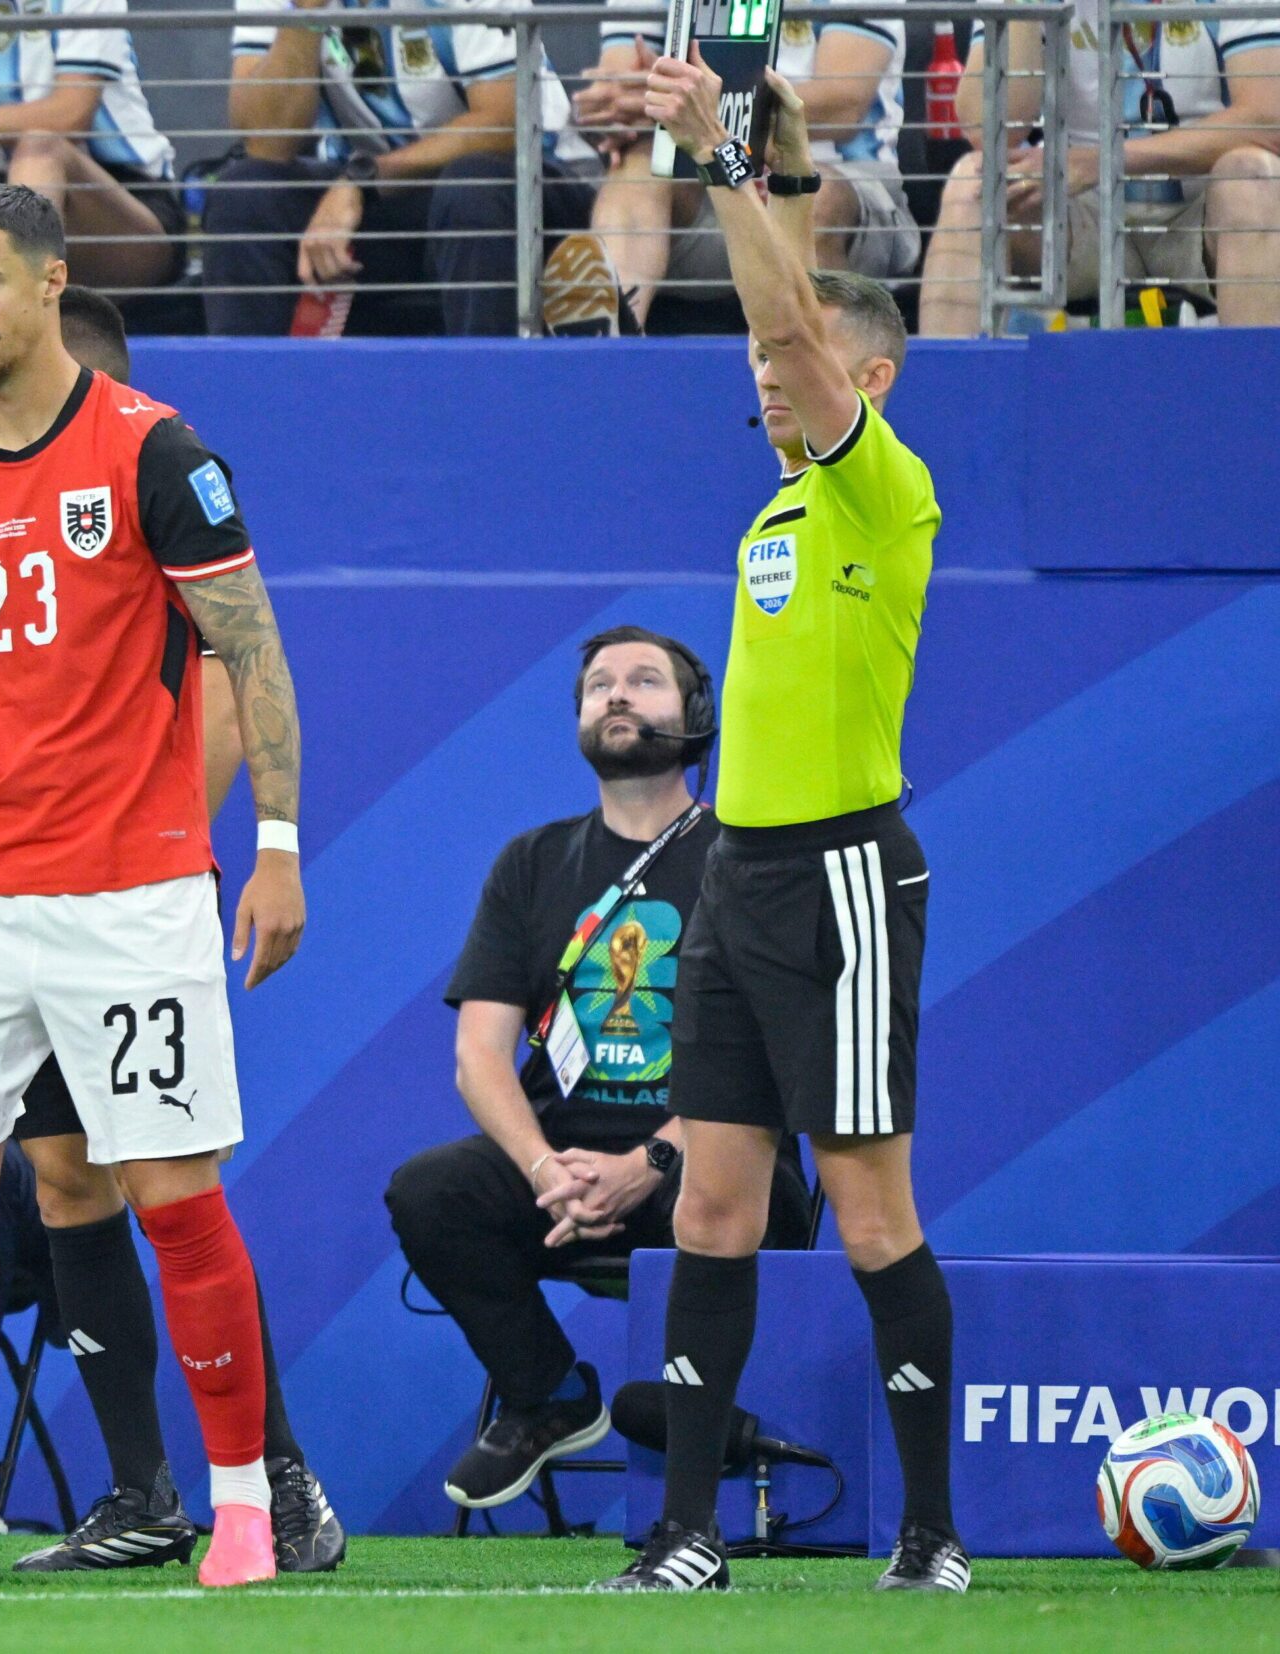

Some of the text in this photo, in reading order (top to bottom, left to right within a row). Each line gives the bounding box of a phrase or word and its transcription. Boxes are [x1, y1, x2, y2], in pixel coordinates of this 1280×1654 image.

[749, 540, 791, 563] FIFA
[750, 571, 792, 585] REFEREE
[832, 580, 870, 602] Rexona
[763, 600, 783, 609] 2026
[103, 997, 185, 1095] 23
[595, 1043, 646, 1065] FIFA
[582, 1086, 670, 1106] ALLAS
[964, 1384, 1280, 1447] FIFA WO
